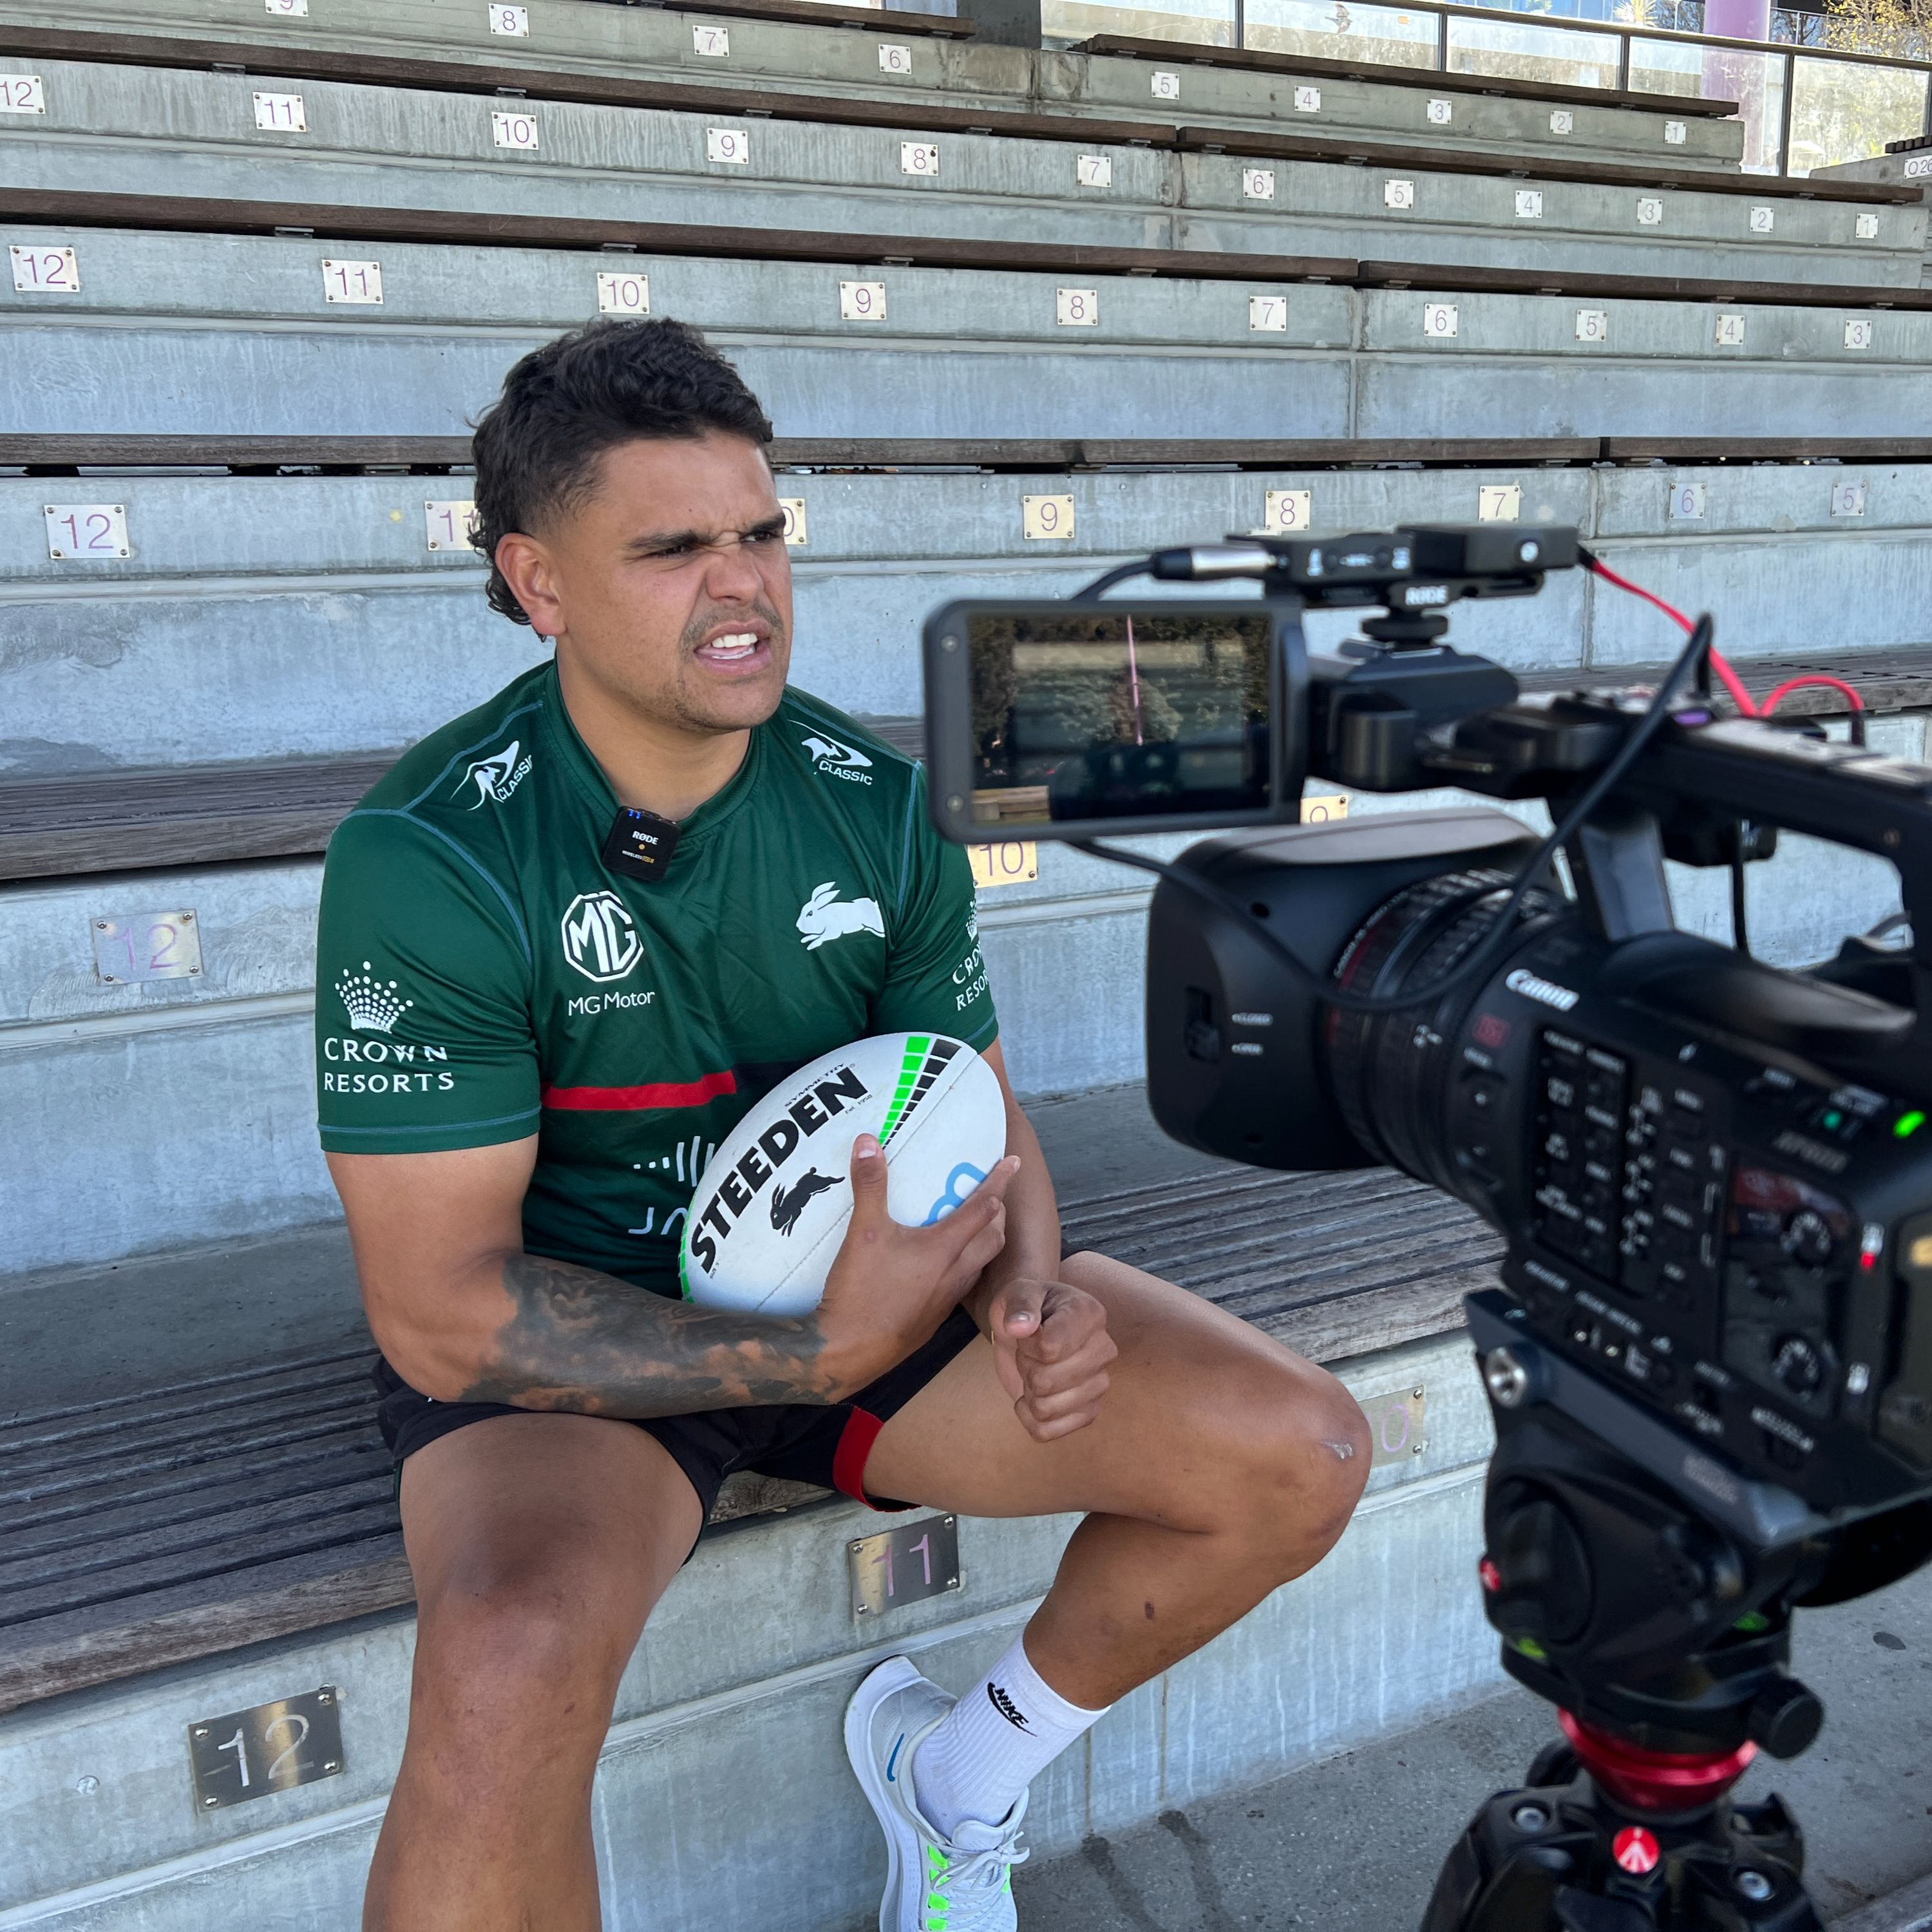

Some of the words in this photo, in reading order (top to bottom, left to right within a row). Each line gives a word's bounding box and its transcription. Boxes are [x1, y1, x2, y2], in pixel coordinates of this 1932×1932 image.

[502, 10, 516, 31] 8
[705, 32, 717, 51] 7
[889, 51, 901, 68] 6
[0, 81, 34, 108] 12
[1160, 77, 1170, 94] 5
[1302, 92, 1312, 107] 4
[265, 100, 293, 125] 11
[1435, 104, 1444, 120] 3
[1557, 115, 1565, 131] 2
[500, 119, 530, 144] 10
[721, 135, 735, 158] 9
[913, 148, 926, 170] 8
[1090, 161, 1100, 180] 7
[1253, 175, 1264, 194] 6
[1394, 185, 1403, 203] 5
[1524, 196, 1533, 211] 4
[1645, 204, 1654, 220] 3
[1758, 212, 1766, 227] 2
[24, 254, 67, 285] 12
[336, 268, 368, 297] 11
[608, 279, 639, 308] 10
[855, 288, 871, 314] 9
[1070, 296, 1085, 319] 8
[1262, 302, 1275, 326] 7
[1435, 310, 1447, 332] 6
[1586, 316, 1598, 337] 5
[1725, 321, 1734, 339] 4
[1853, 325, 1862, 345] 3
[1280, 497, 1296, 525] 8
[1493, 492, 1507, 516] 7
[1681, 489, 1695, 513] 6
[1842, 487, 1854, 511] 5
[1040, 502, 1058, 531] 9
[61, 514, 114, 549] 12
[819, 760, 873, 785] CLASSIC
[980, 842, 1023, 876] 10
[113, 923, 182, 971] 12
[568, 899, 637, 972] MG
[569, 996, 600, 1016] MG
[604, 992, 656, 1010] Motor
[324, 1037, 448, 1063] CROWN
[324, 1072, 455, 1093] RESORTS
[691, 1066, 868, 1274] STEEDEN
[872, 1534, 931, 1596] 11
[994, 1687, 1029, 1725] NIKE
[218, 1714, 314, 1787] 12
